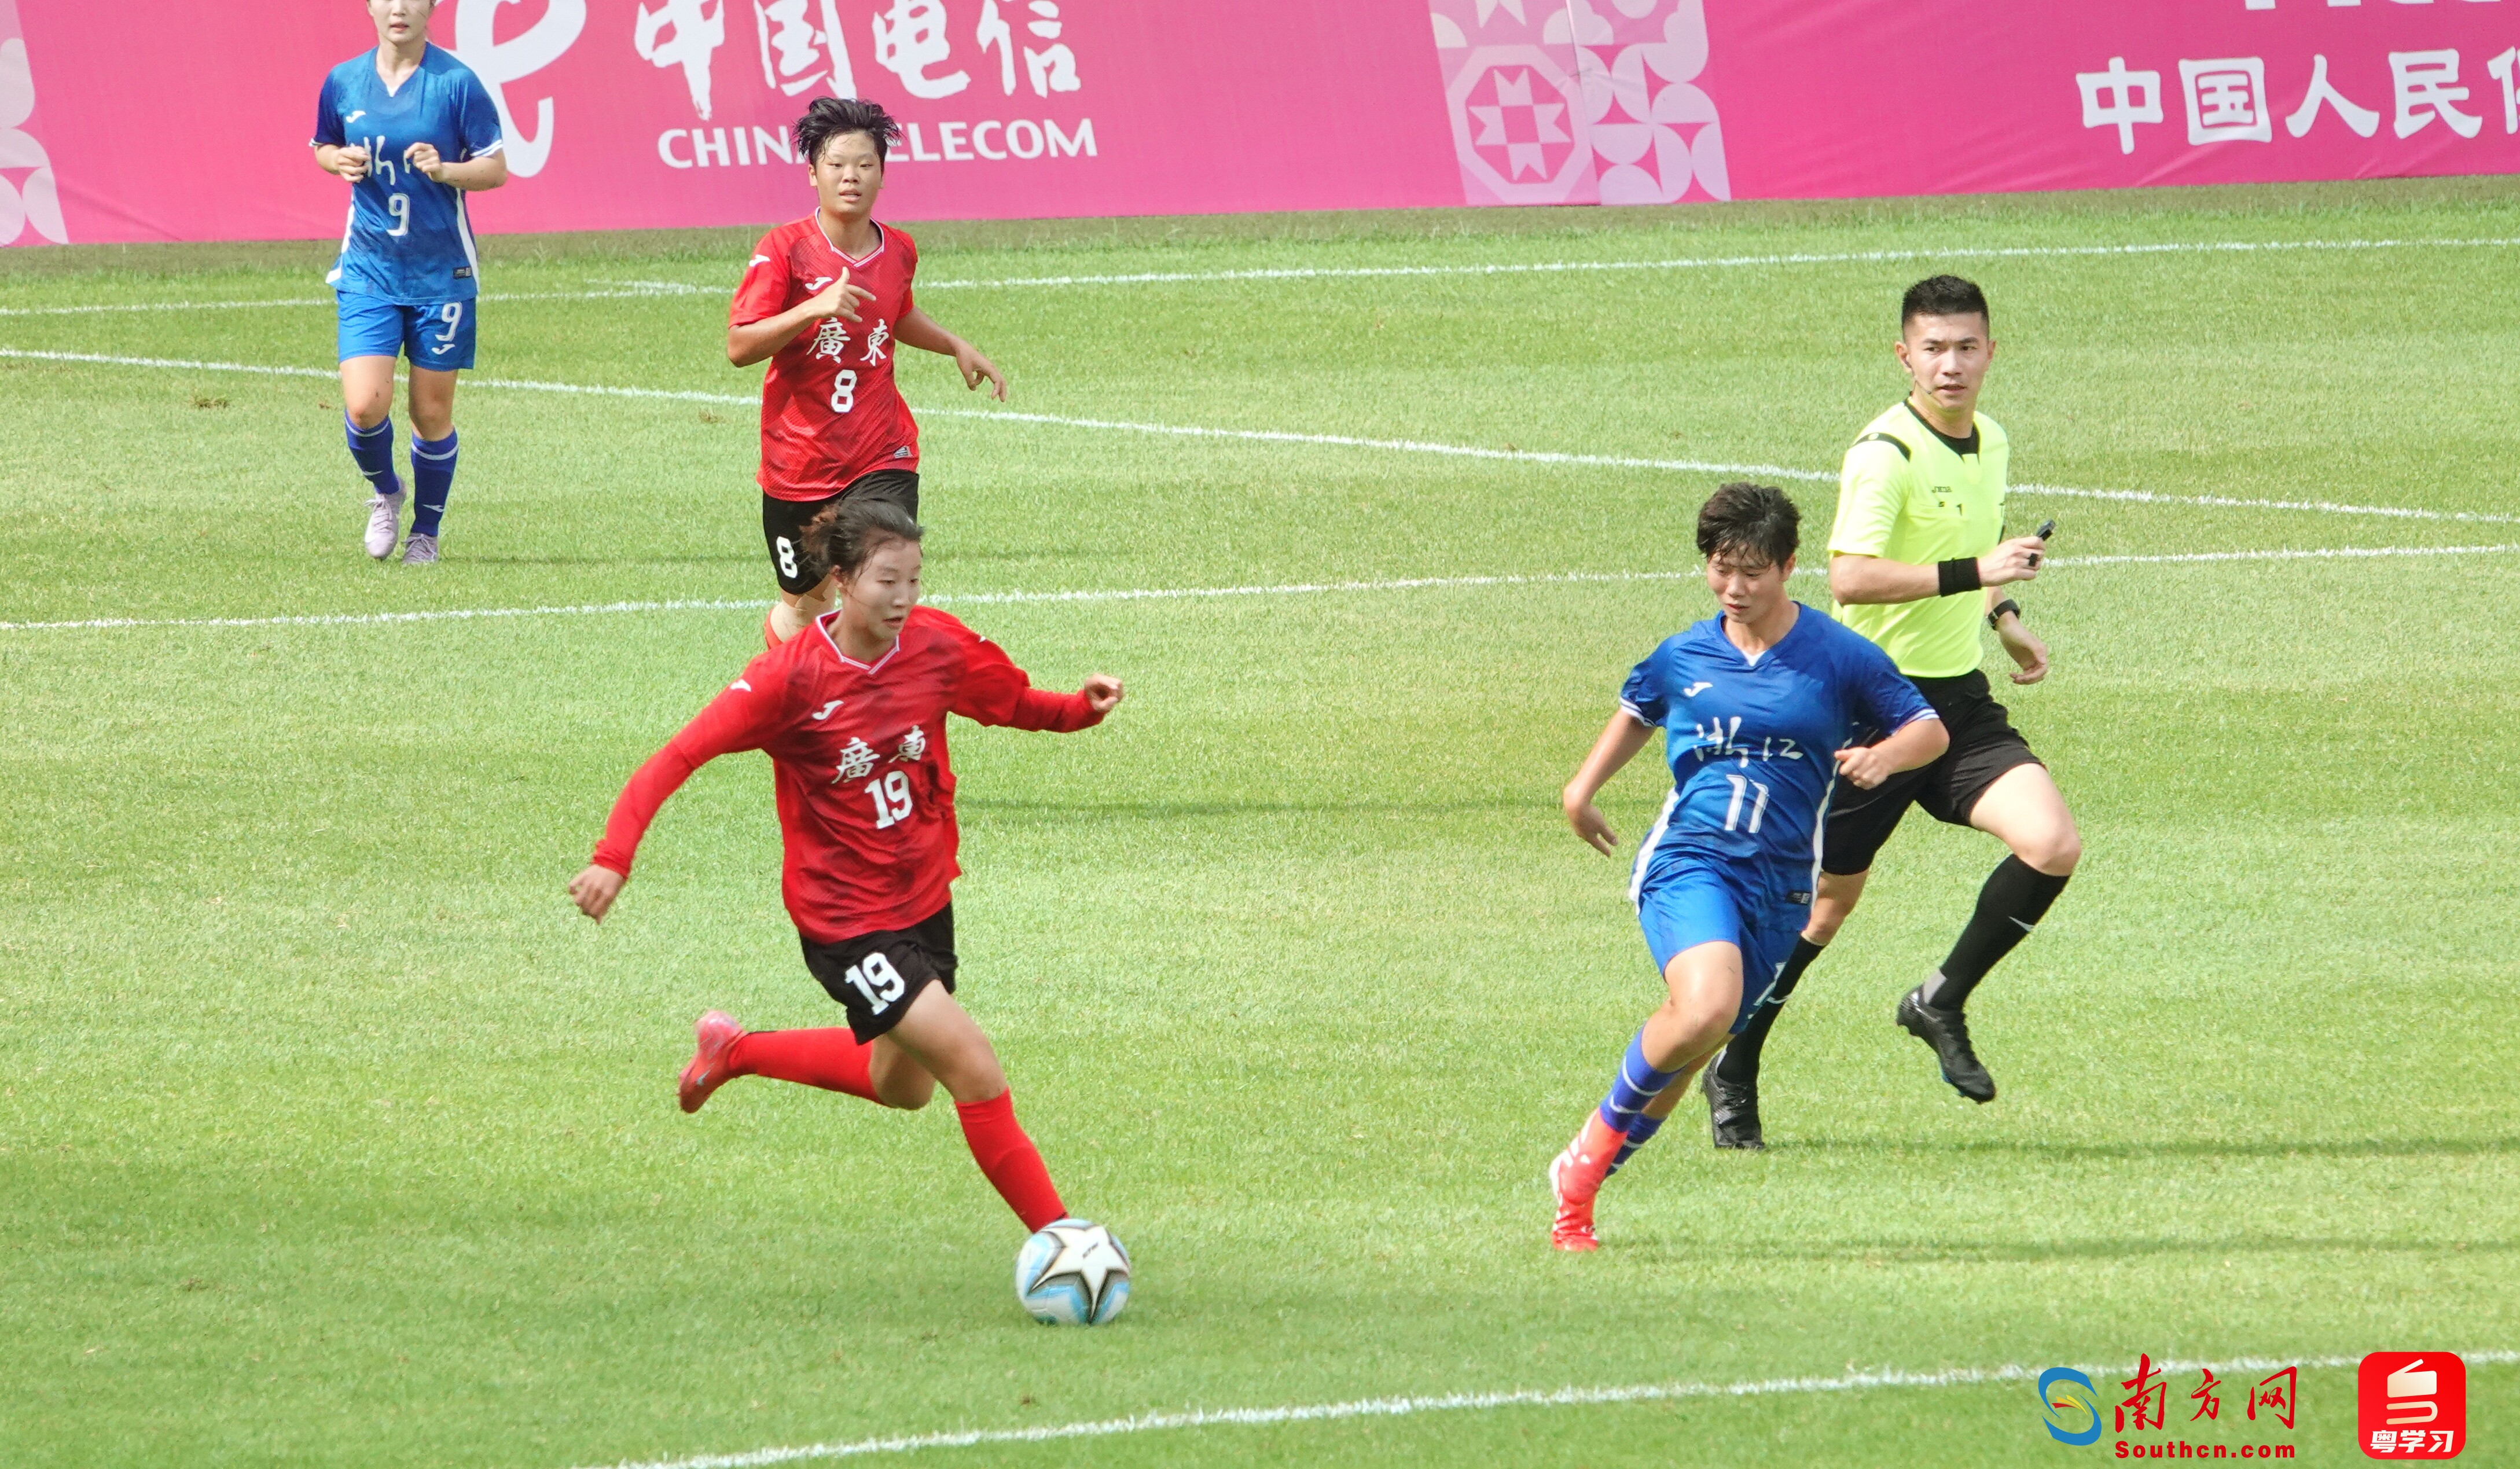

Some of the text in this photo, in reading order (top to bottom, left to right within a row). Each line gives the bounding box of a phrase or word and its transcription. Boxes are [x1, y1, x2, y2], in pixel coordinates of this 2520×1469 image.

[634, 0, 1081, 120] 中国电信
[657, 126, 809, 168] CHIN
[387, 194, 410, 236] 9
[435, 303, 463, 341] 9
[806, 317, 890, 366] 廣東
[831, 369, 857, 413] 8
[776, 536, 798, 578] 8
[831, 725, 926, 784] 廣東
[1692, 716, 1803, 768] 浙江
[864, 770, 913, 829] 19
[1724, 774, 1769, 833] 11
[844, 953, 905, 1015] 19
